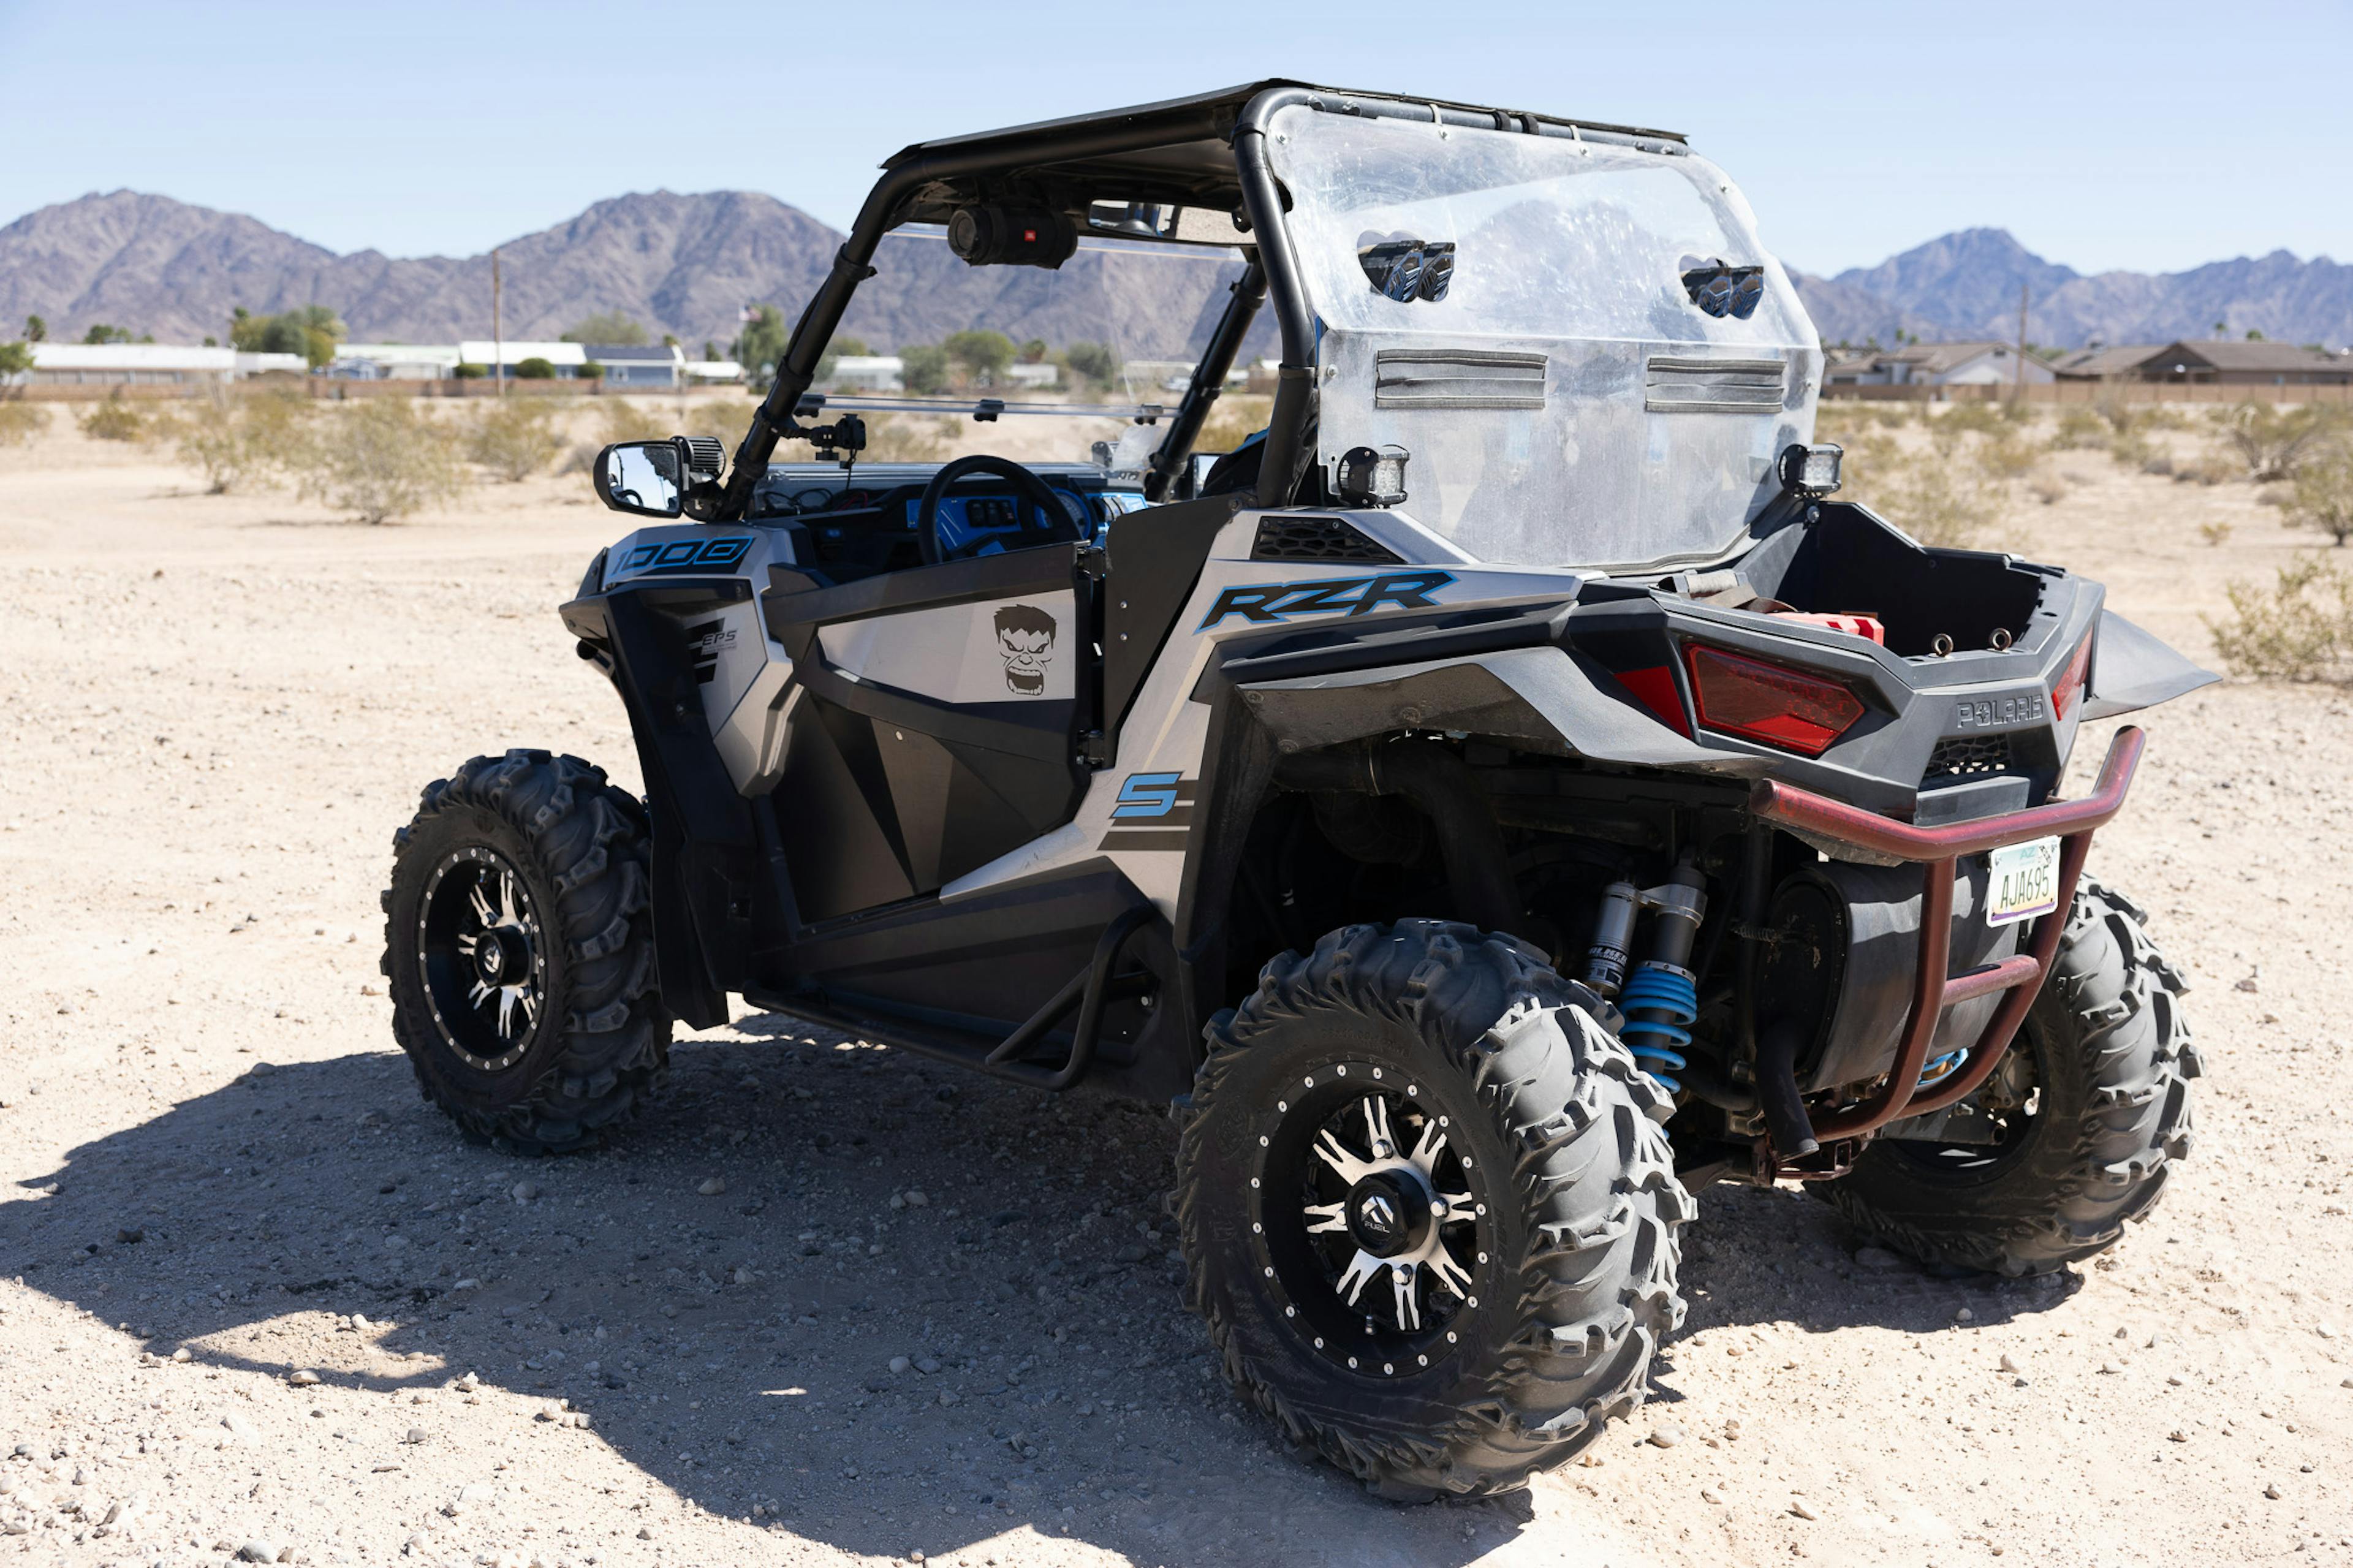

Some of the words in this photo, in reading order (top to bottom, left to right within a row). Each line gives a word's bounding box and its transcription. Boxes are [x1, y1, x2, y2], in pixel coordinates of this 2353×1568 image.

[610, 536, 754, 576] 1000
[1193, 569, 1460, 635] RZR
[702, 630, 737, 645] EPS
[1957, 694, 2044, 729] POLARIS
[1112, 771, 1184, 818] S
[2000, 865, 2050, 909] AJA695
[1364, 1220, 1390, 1234] FUEL
